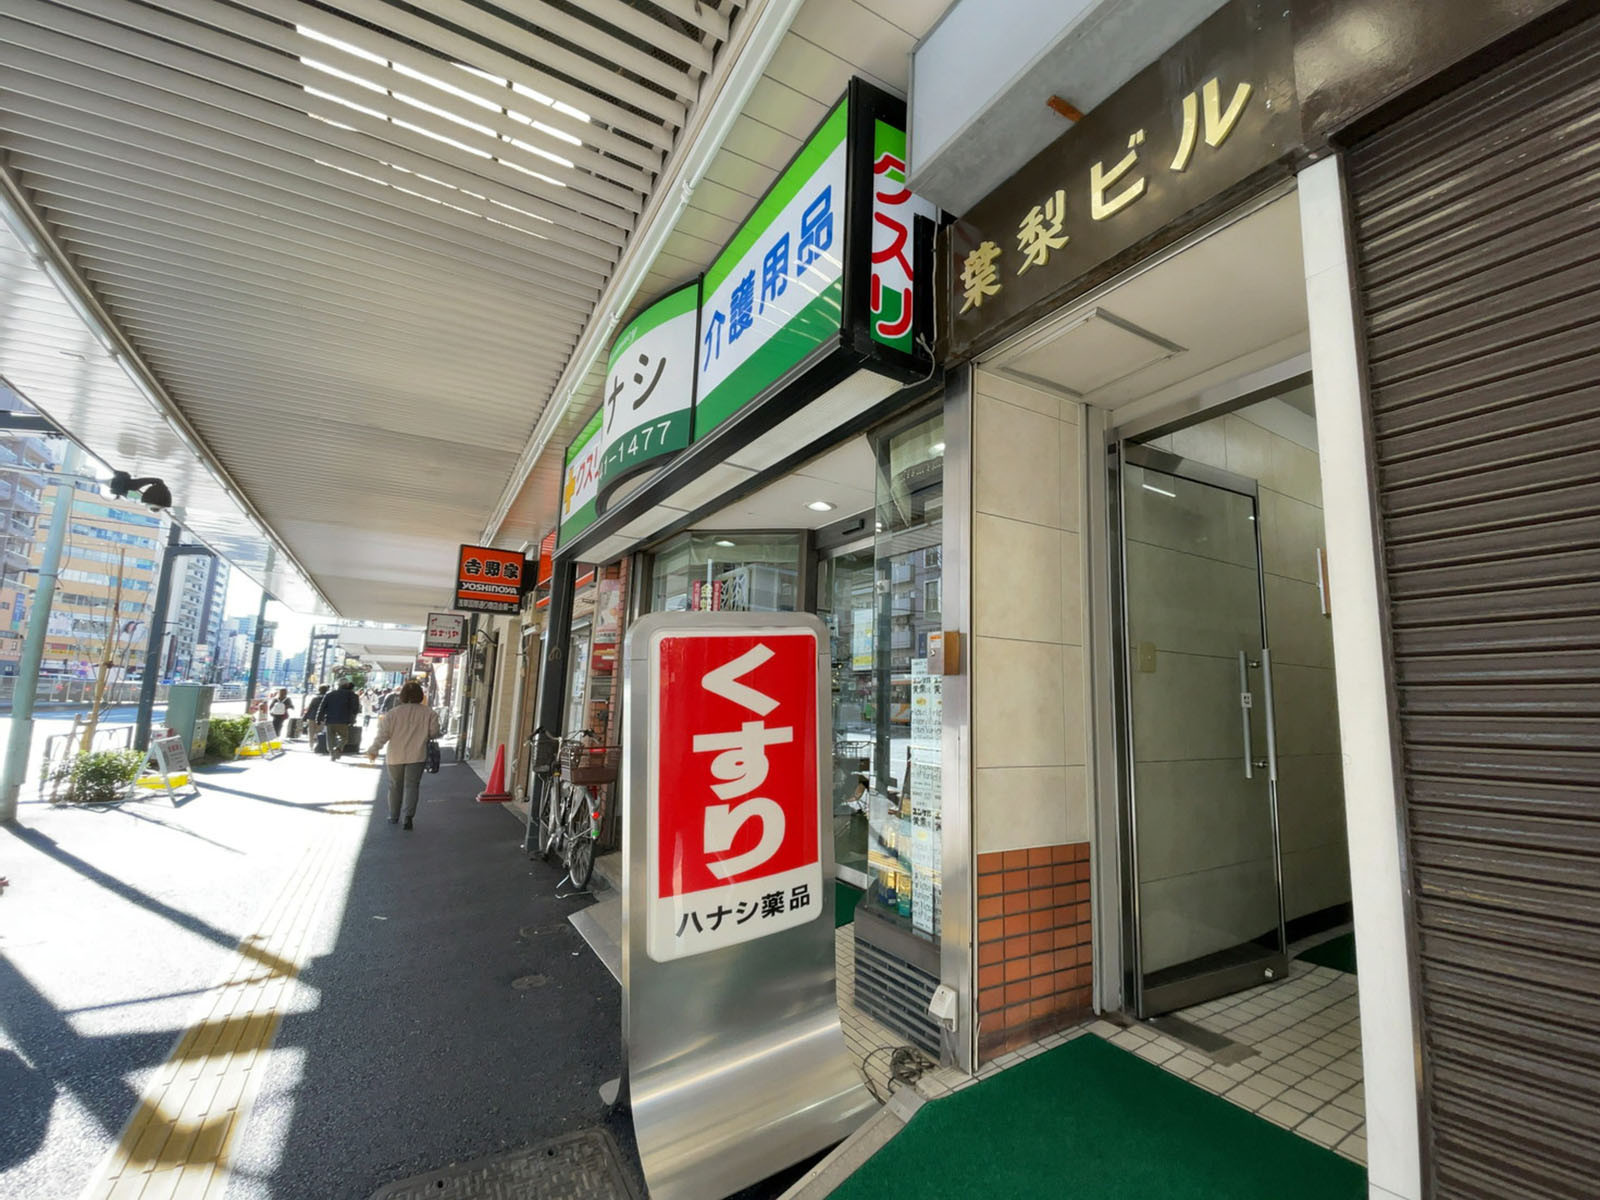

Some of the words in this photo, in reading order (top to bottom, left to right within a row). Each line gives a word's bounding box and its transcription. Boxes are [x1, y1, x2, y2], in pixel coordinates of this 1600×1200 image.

[703, 184, 834, 373] 介護用品
[872, 153, 914, 337] クスリ
[959, 76, 1251, 314] 葉梨ビル
[464, 557, 520, 580] 吉野家
[693, 643, 793, 881] くすり
[676, 884, 810, 938] ハナシ薬品
